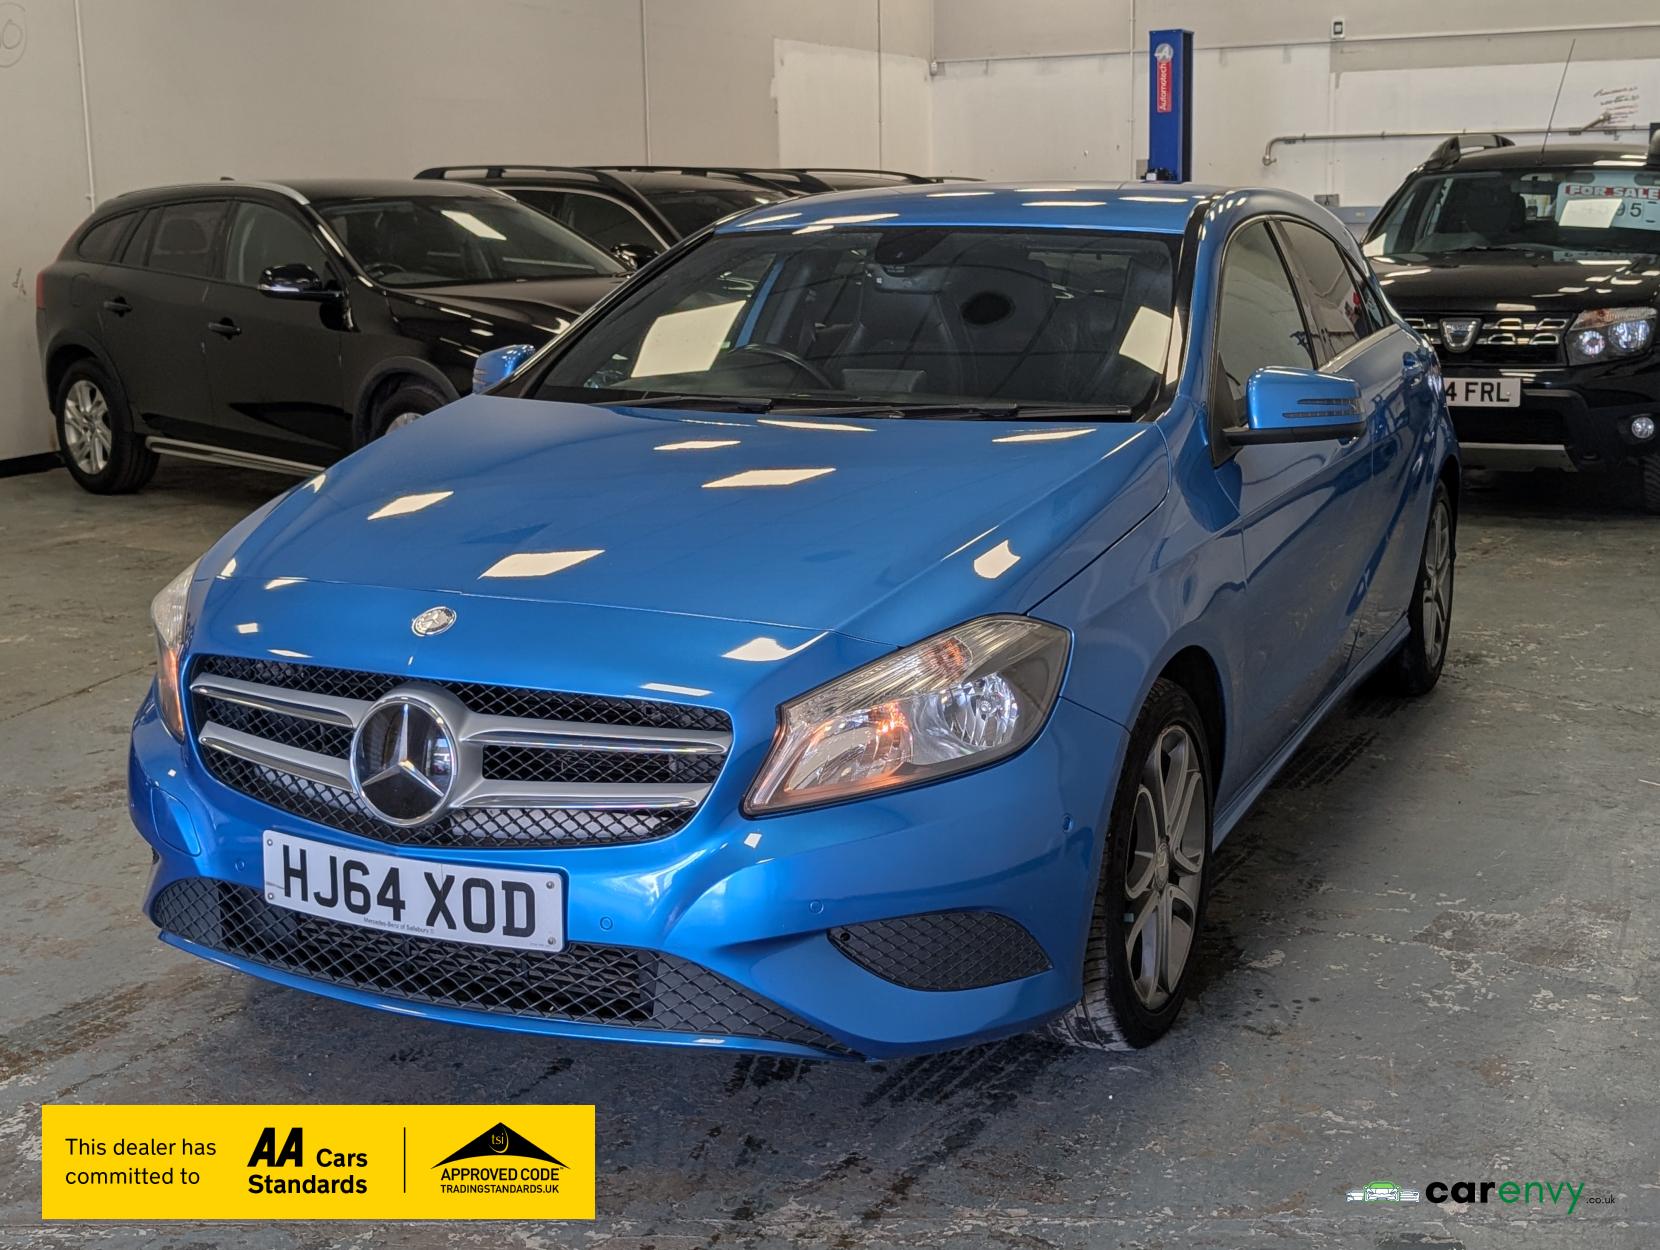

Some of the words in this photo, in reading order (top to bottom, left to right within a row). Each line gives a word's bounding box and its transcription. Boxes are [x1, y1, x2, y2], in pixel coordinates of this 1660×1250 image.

[1159, 63, 1167, 111] Automotech
[1570, 185, 1606, 196] FOR
[1612, 186, 1660, 199] SALE
[1464, 381, 1510, 402] FRL
[282, 844, 406, 922] HJ64
[424, 871, 536, 938] XOD
[363, 916, 400, 929] Mercedes-Benz
